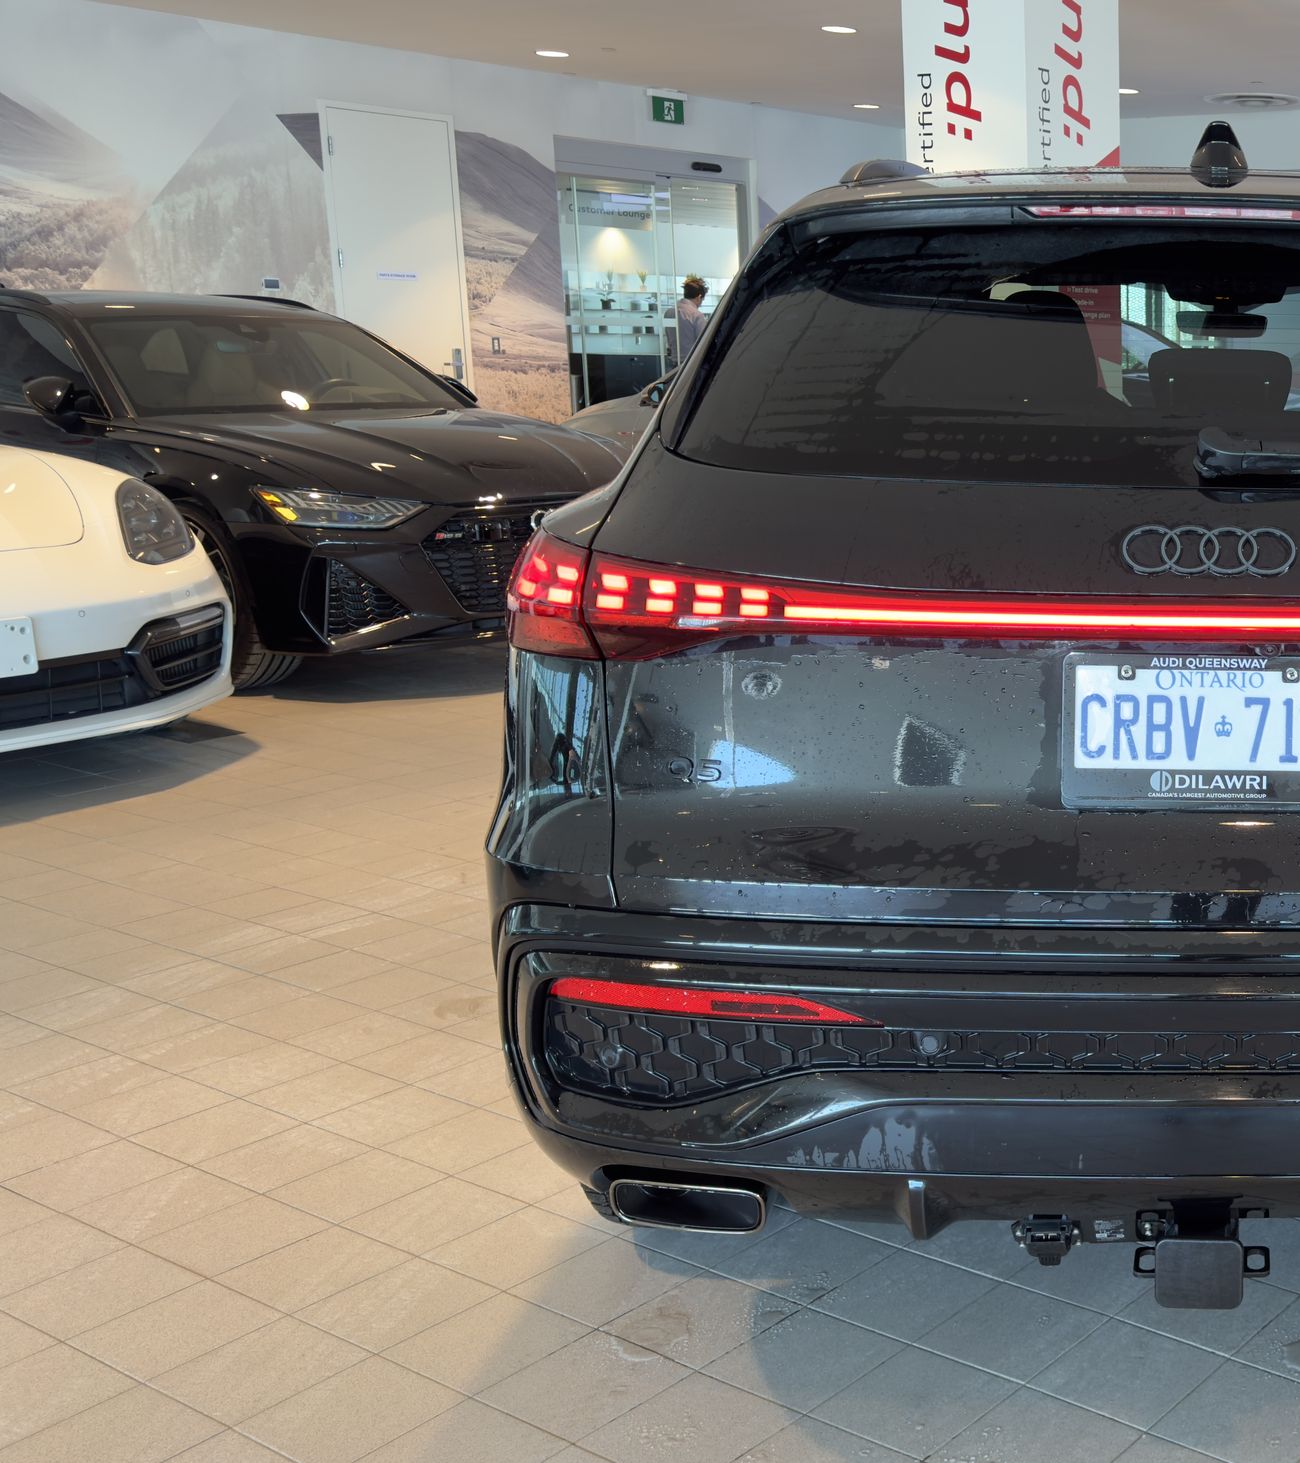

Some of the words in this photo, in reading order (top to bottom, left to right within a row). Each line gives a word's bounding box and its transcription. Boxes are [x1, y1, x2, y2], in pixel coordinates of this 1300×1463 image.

[1038, 67, 1052, 169] rtified
[617, 208, 651, 221] Lounge
[1150, 657, 1182, 667] AUDI
[1186, 658, 1268, 669] QUEENSWAY
[1080, 693, 1205, 761] CRBV
[670, 756, 722, 783] Q5
[1174, 774, 1267, 790] DILAWRI
